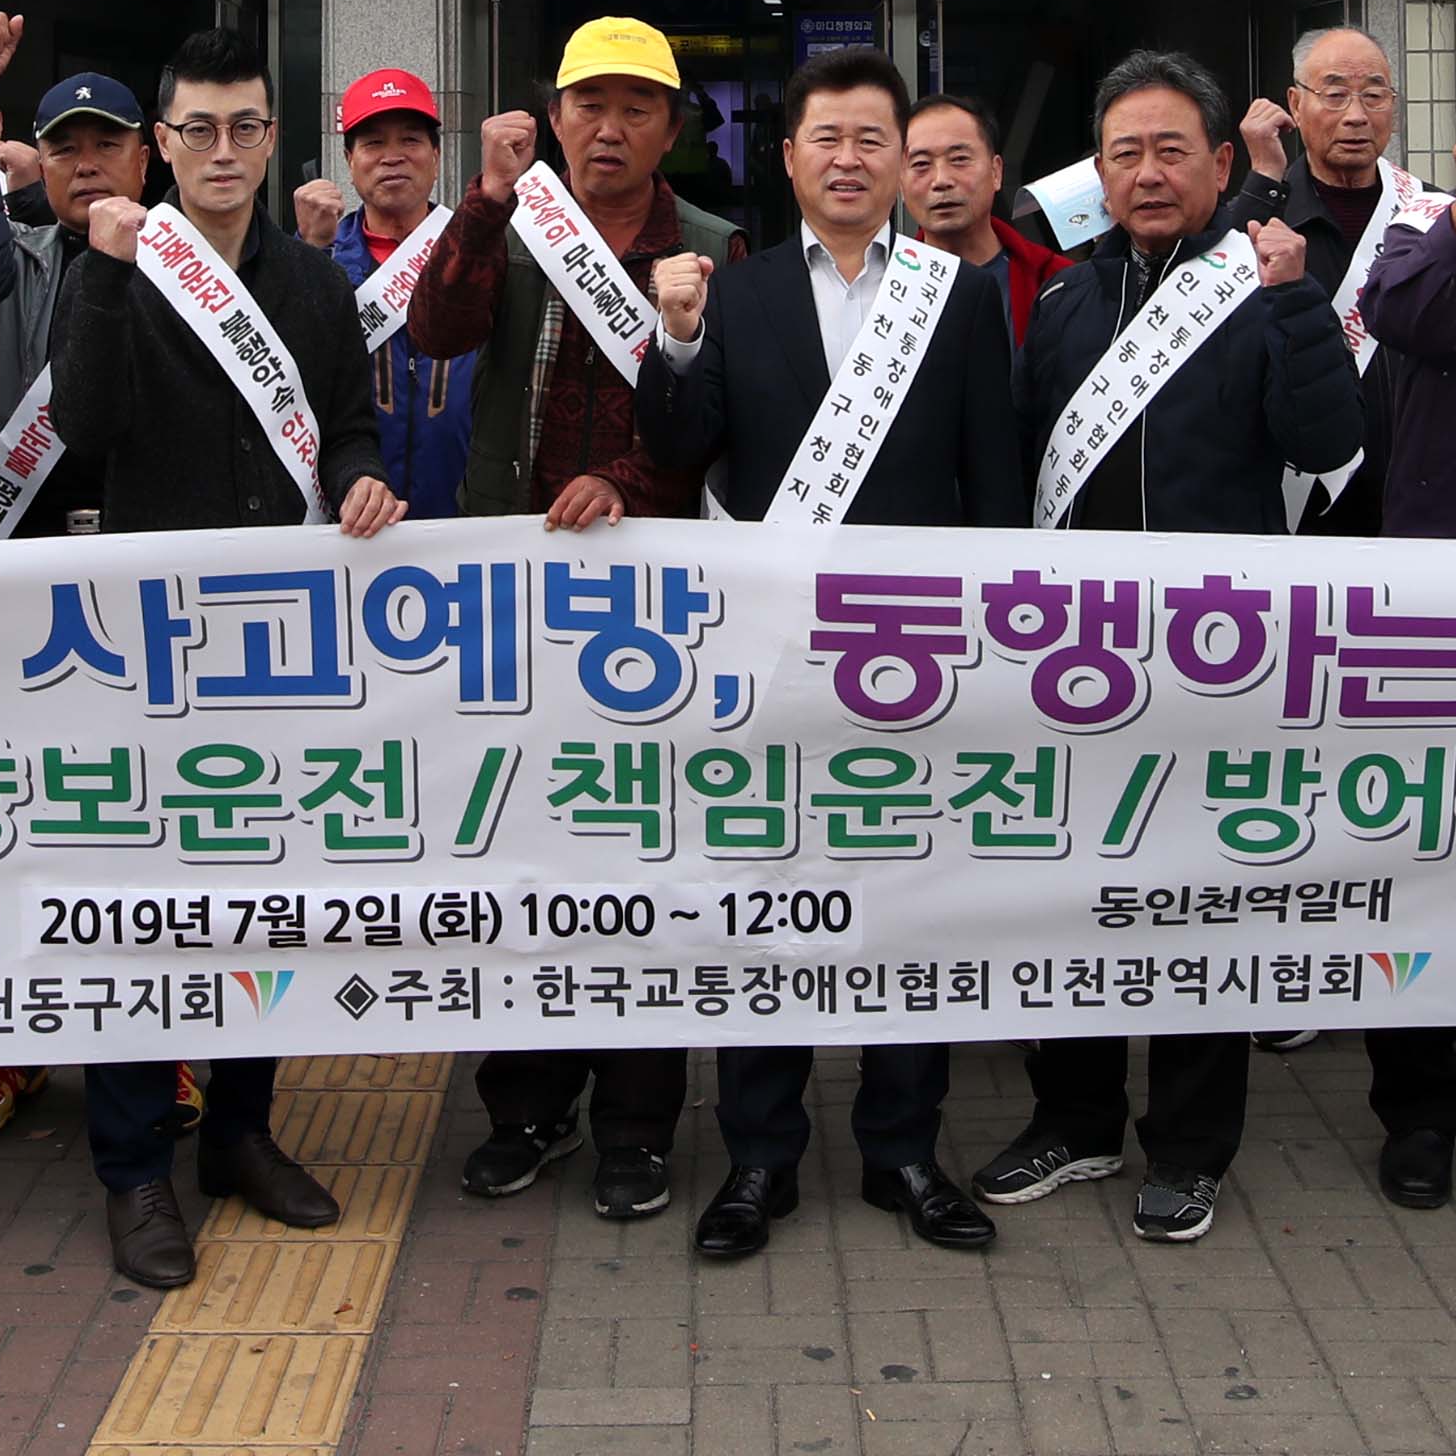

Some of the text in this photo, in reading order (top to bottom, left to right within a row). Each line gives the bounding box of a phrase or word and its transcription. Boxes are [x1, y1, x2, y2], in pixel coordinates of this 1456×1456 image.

[139, 220, 236, 315] 난폭운전
[561, 242, 645, 341] 무단횡단
[21, 562, 743, 719] 사고예방,
[548, 741, 1058, 850] 책임운전
[39, 893, 212, 948] 2019년
[226, 893, 308, 947] 7월
[321, 895, 401, 945] 2일
[419, 890, 505, 946] (화)
[521, 891, 655, 937] 10:00
[720, 888, 852, 935] 12:00
[1092, 878, 1393, 929] 동인천역일대
[382, 968, 484, 1022] 주최
[531, 959, 991, 1017] 한국교통장애인협회
[1011, 952, 1366, 1013] 인천광역시협회
